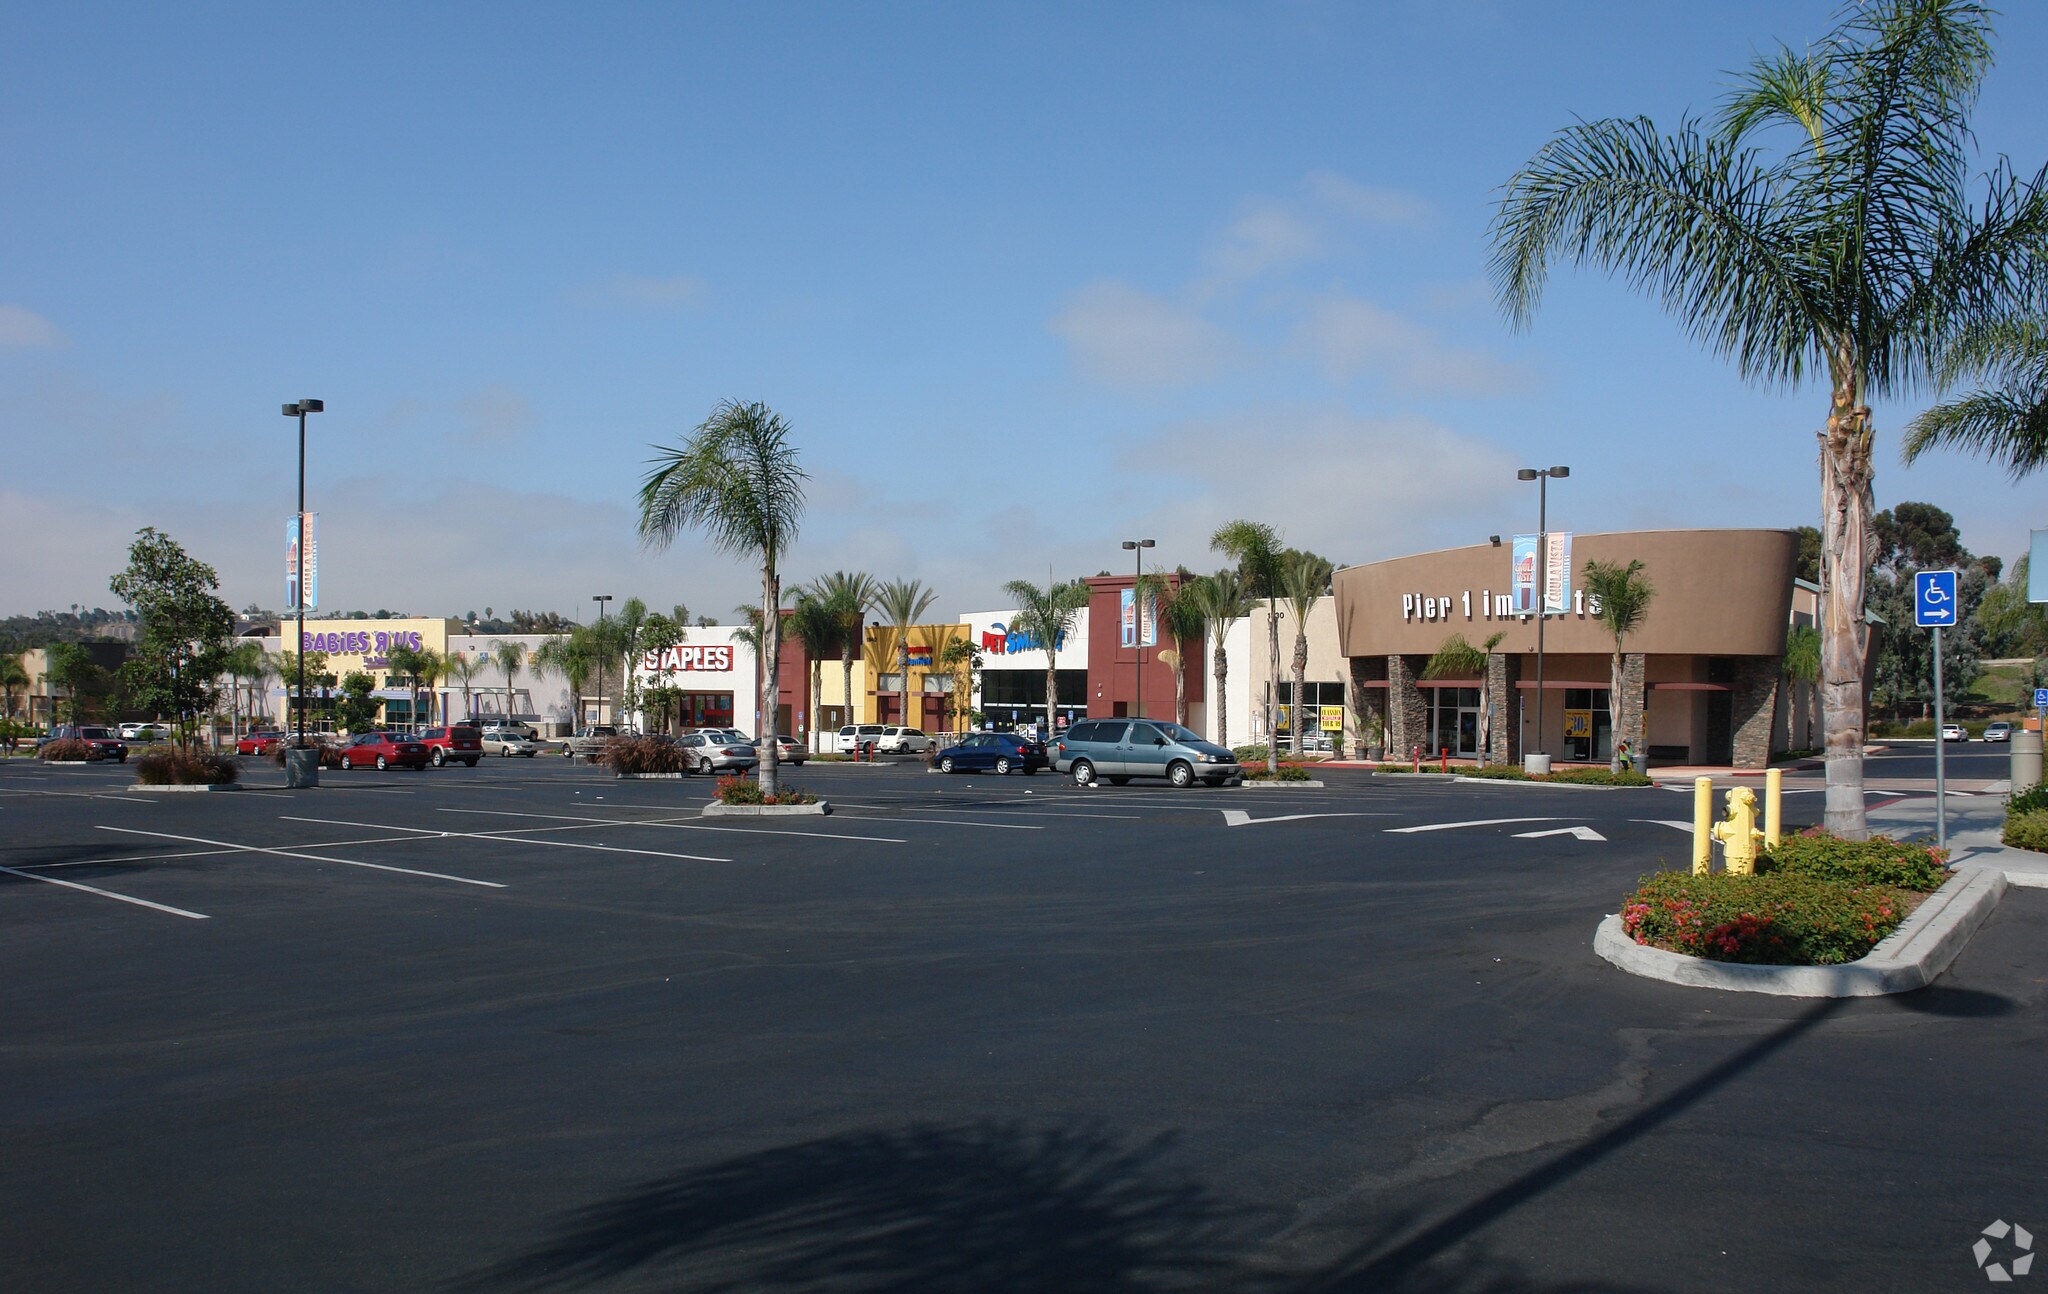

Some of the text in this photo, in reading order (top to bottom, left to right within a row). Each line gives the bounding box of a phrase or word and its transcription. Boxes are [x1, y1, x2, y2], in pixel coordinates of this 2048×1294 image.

[1548, 539, 1563, 602] CHULA VISTA
[1402, 592, 1450, 619] Pier
[1461, 590, 1471, 617] 1
[645, 646, 730, 670] STAPLES
